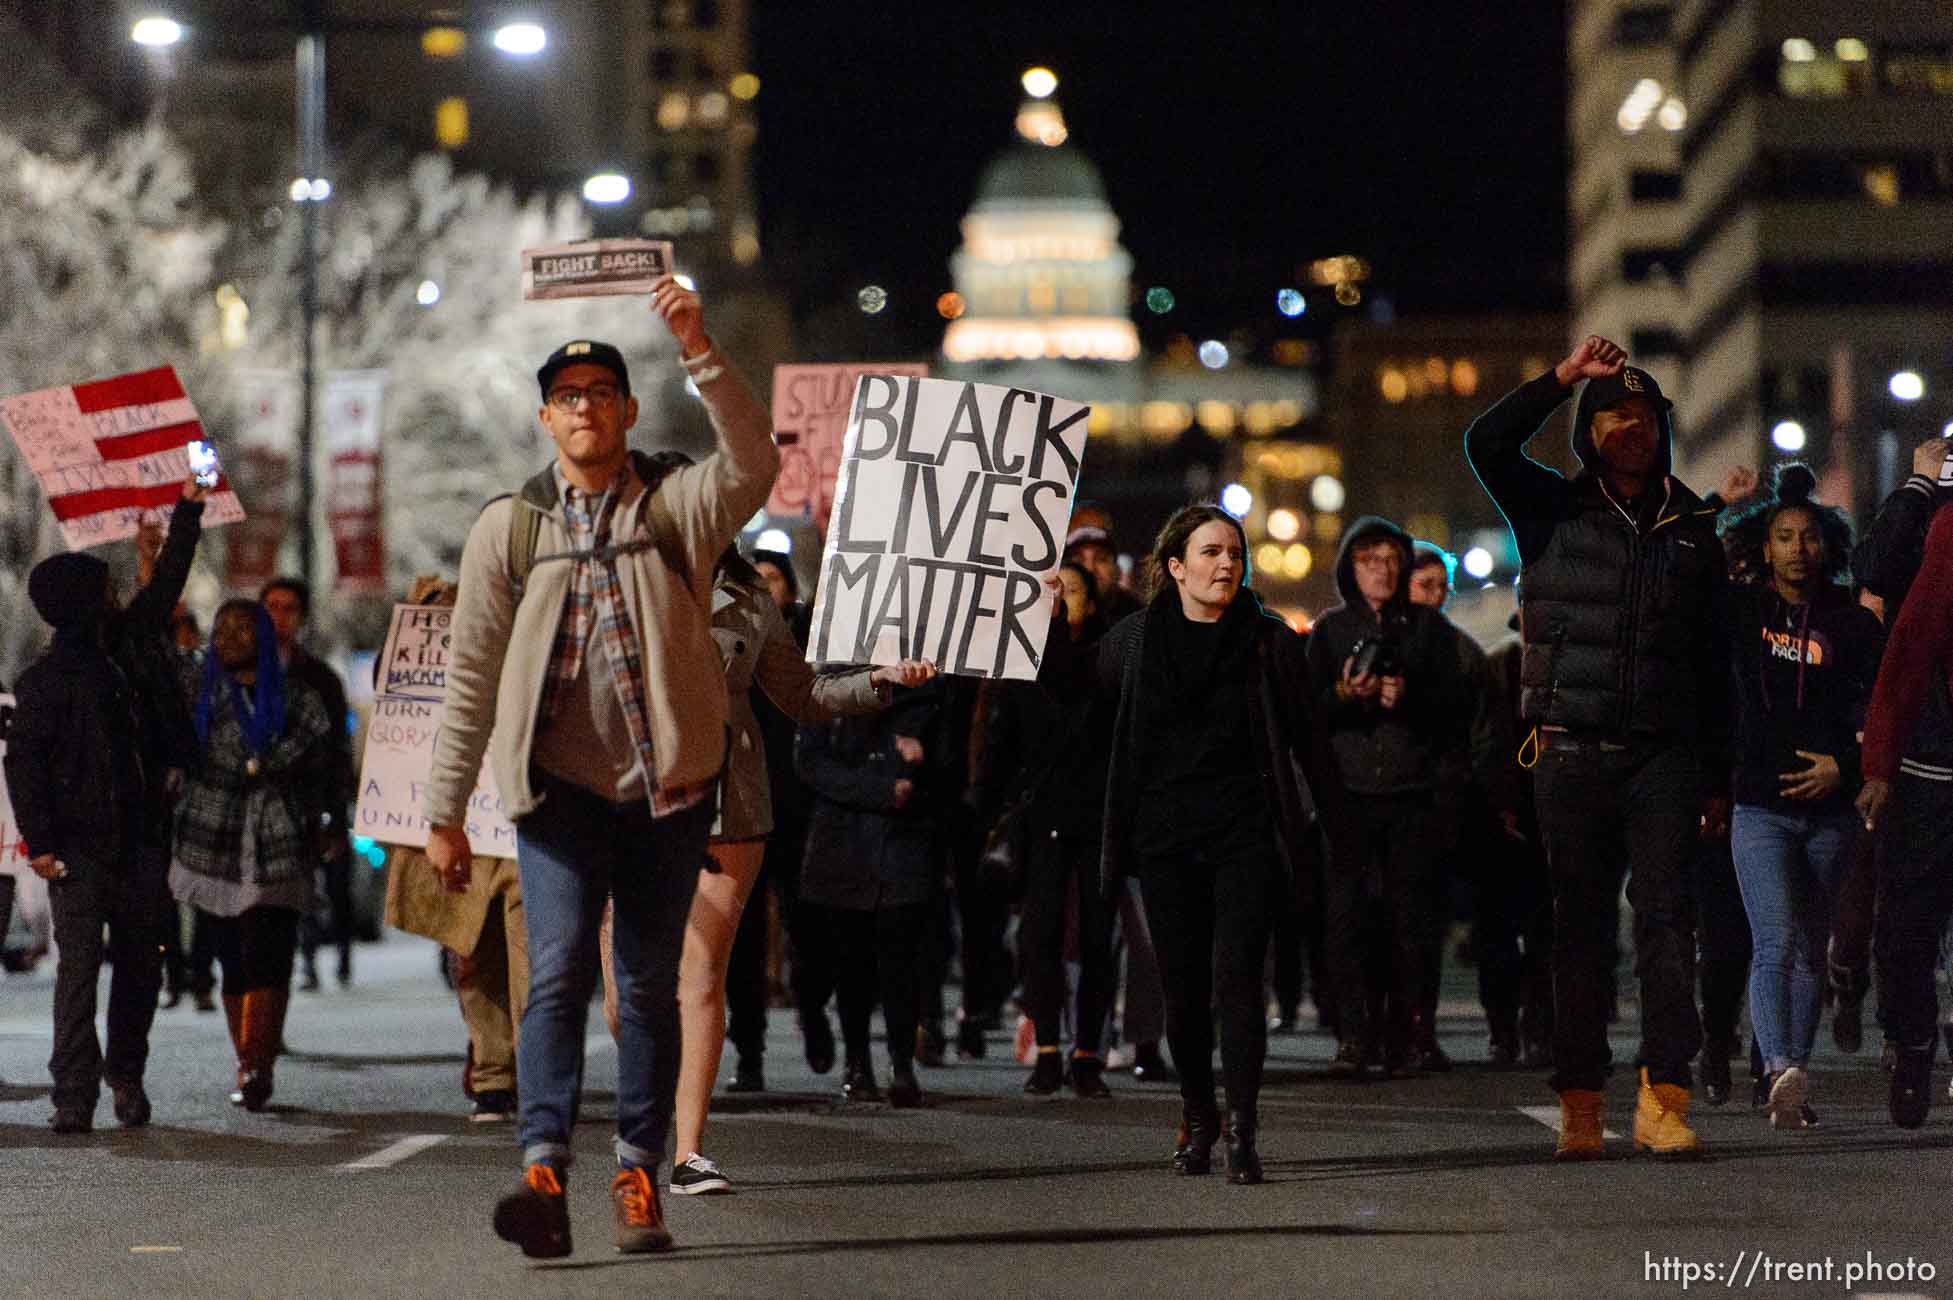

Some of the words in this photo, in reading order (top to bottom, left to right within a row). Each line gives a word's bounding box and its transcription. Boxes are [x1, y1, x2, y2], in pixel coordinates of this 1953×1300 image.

[541, 255, 596, 274] FIGHT
[601, 252, 655, 271] BACK!
[854, 374, 1092, 486] BLACK
[837, 458, 1067, 571] LIVES
[412, 611, 451, 628] HO
[815, 554, 1041, 677] MATTER
[374, 700, 432, 719] TURN
